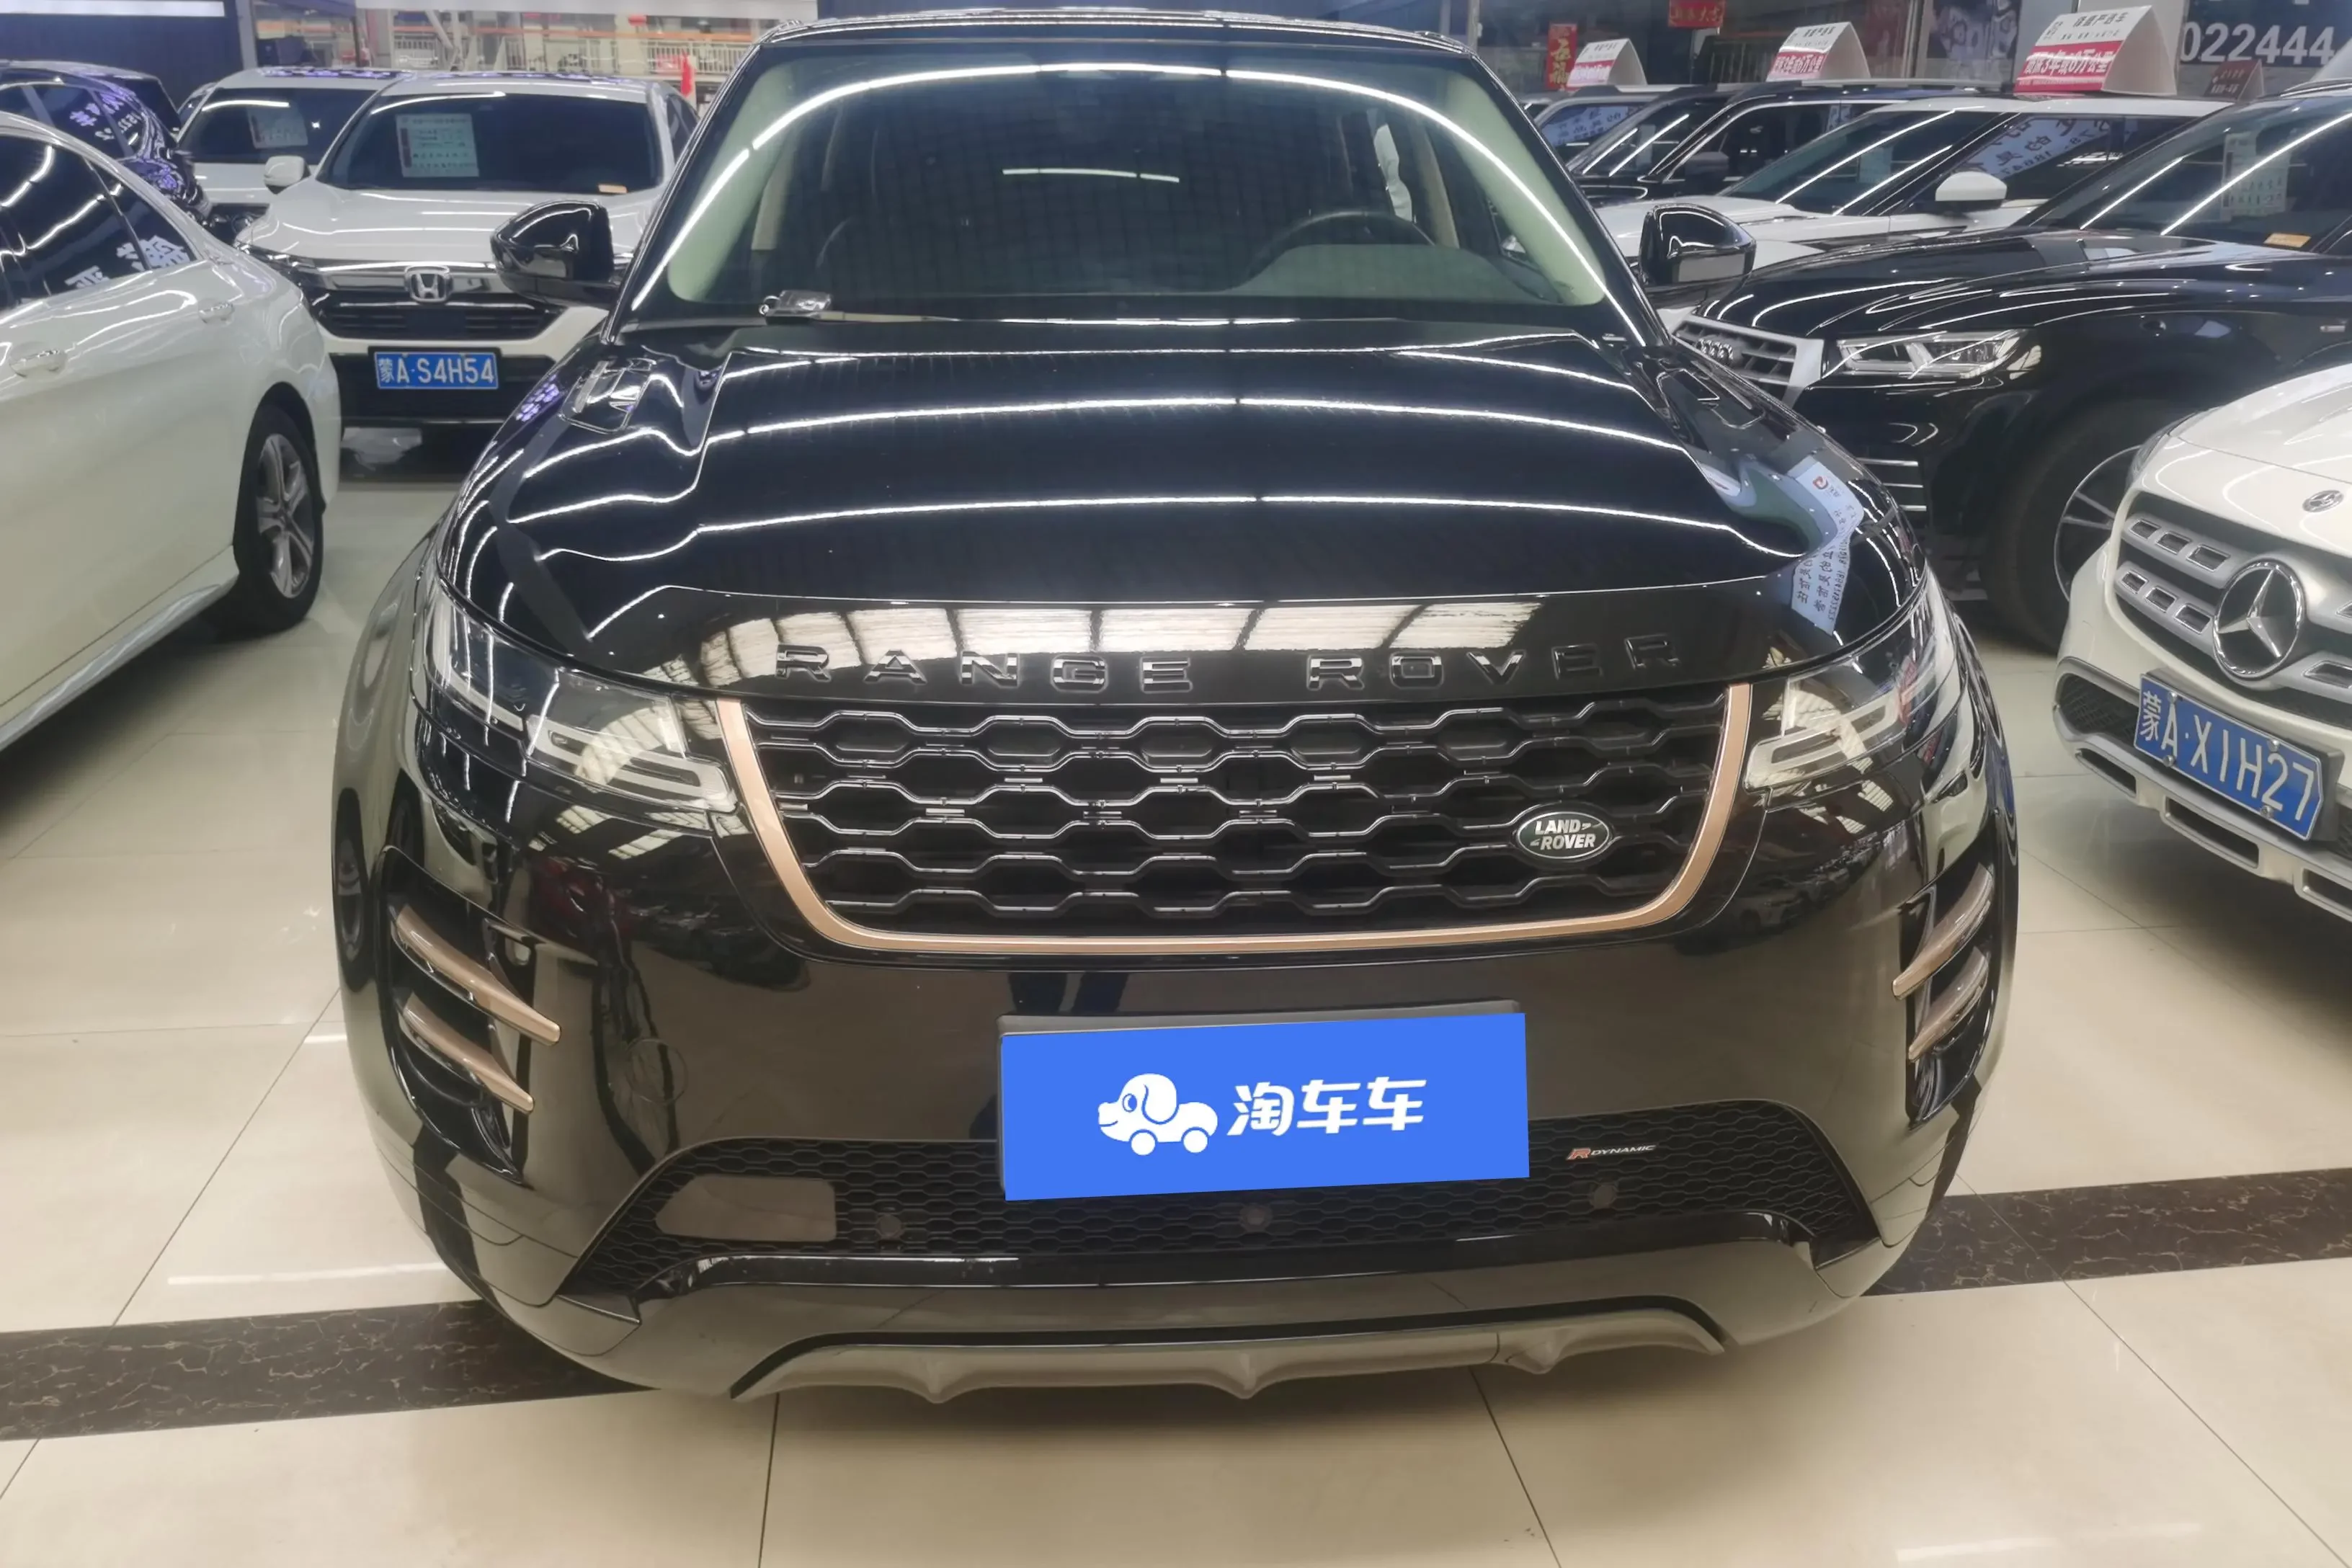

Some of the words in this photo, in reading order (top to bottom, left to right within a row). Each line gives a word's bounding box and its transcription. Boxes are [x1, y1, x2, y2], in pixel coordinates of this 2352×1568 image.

[775, 644, 1193, 692] RANGE
[1306, 633, 1681, 690] ROVER
[1535, 819, 1581, 835] LAND
[1540, 833, 1597, 850] ROVER
[1591, 1145, 1657, 1156] DYNAMIC
